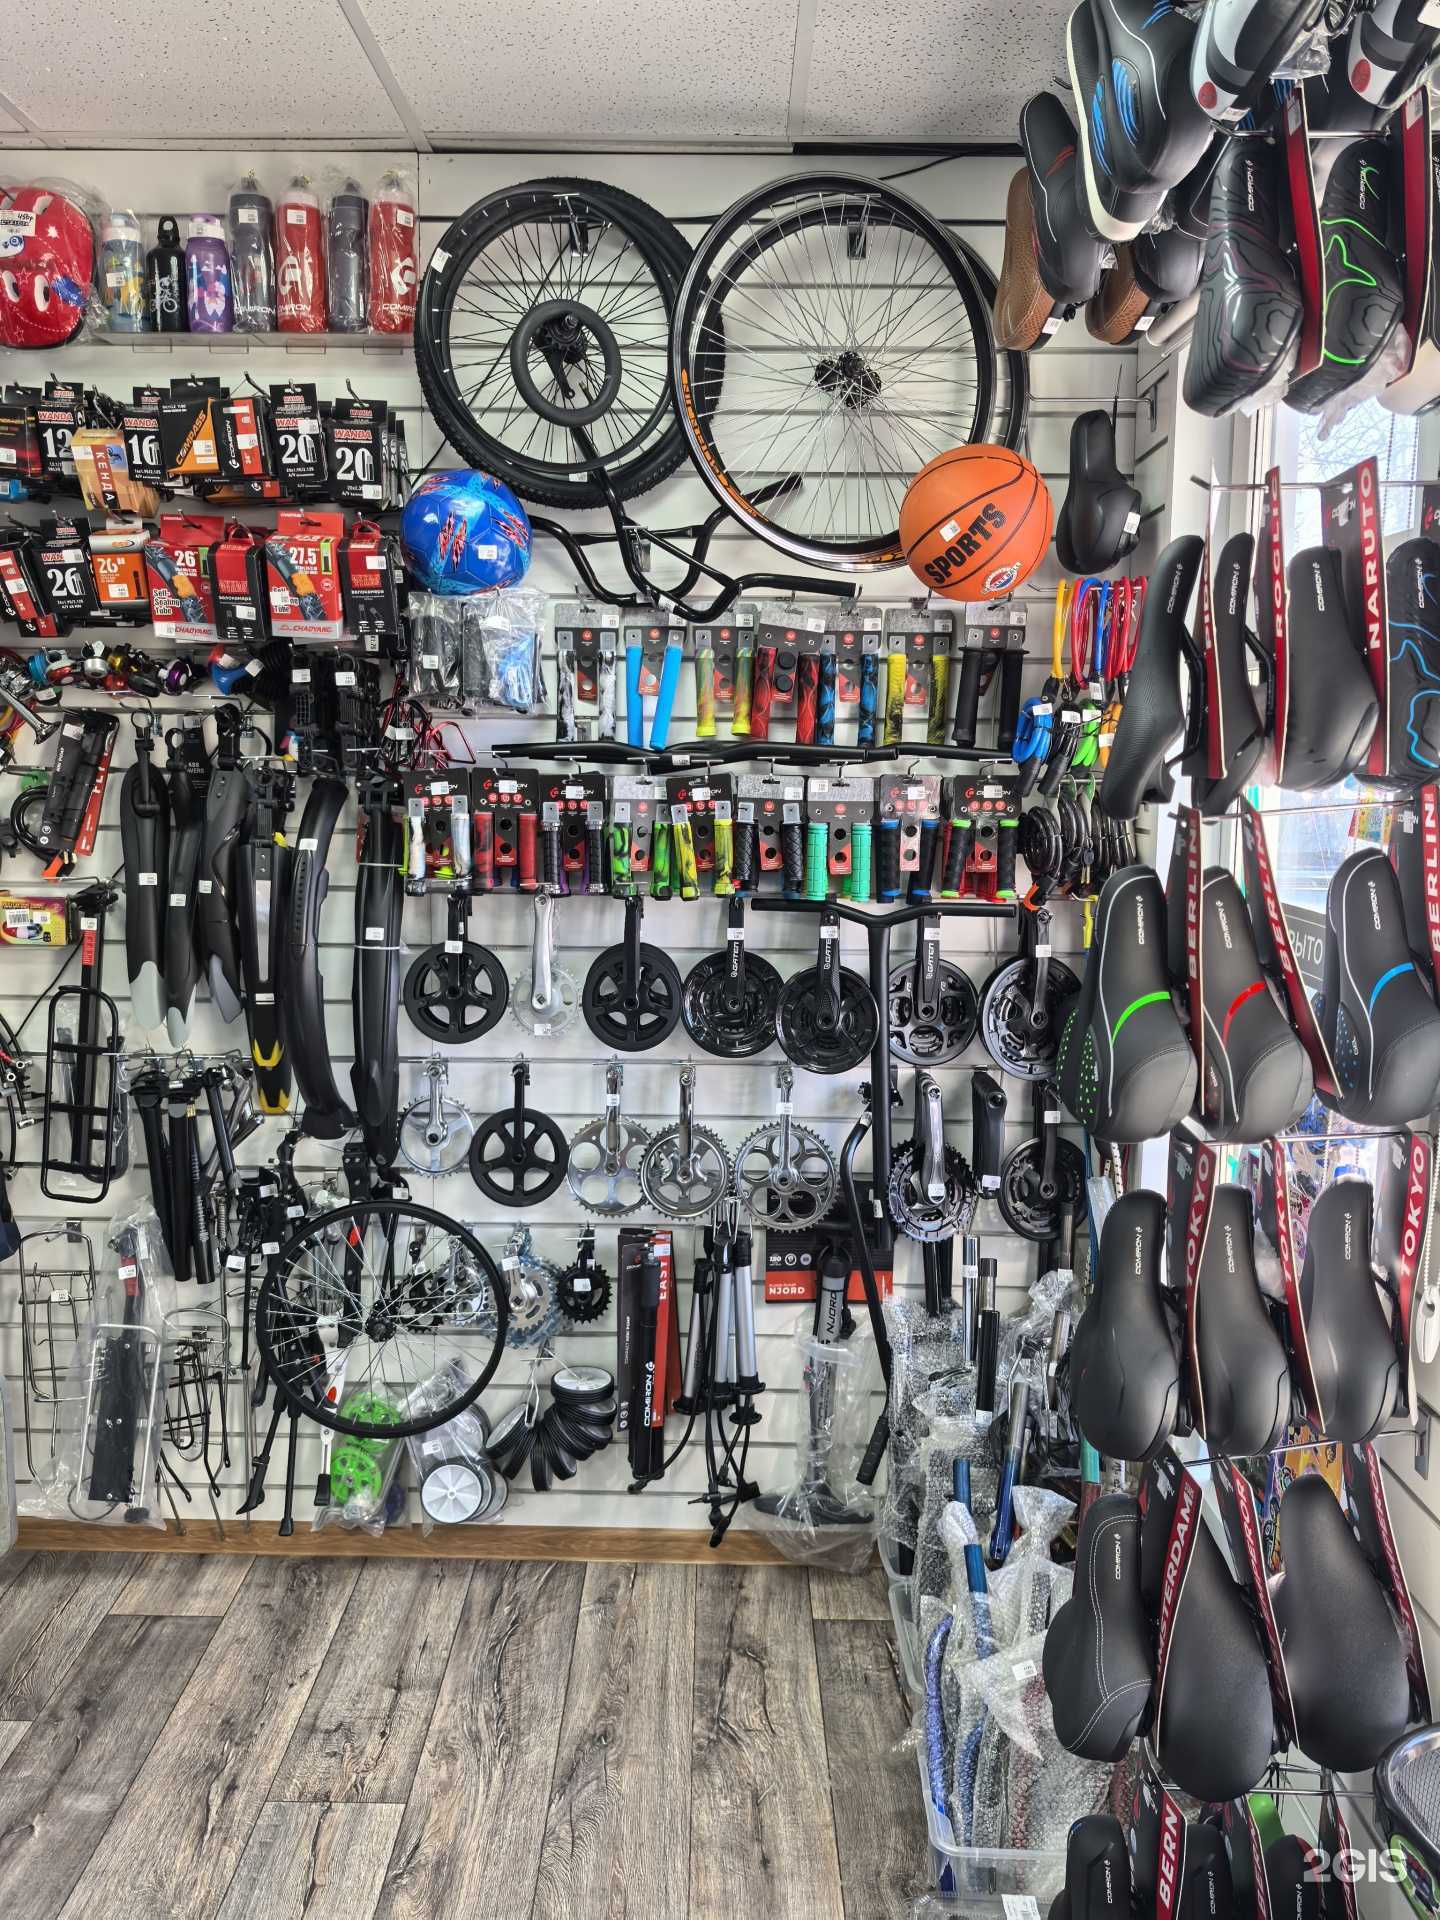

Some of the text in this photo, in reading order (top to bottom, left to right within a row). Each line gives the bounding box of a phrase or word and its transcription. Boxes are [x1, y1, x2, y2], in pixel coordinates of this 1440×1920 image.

[37, 410, 73, 421] WANDA
[123, 417, 158, 427] WANDA
[275, 418, 299, 427] WAN
[334, 429, 373, 440] WANDA
[42, 428, 73, 458] 12
[128, 433, 160, 466] 16
[175, 408, 206, 466] COMPASS
[224, 419, 236, 458] COMIRON
[279, 434, 314, 464] 20
[335, 447, 372, 481] 20
[42, 552, 64, 561] WAN
[924, 503, 1007, 584] SPORTS
[1271, 476, 1283, 638] ROGLIC
[1358, 467, 1380, 649] NARUTO
[47, 567, 85, 597] 26
[153, 589, 171, 598] Self-
[154, 597, 181, 608] Sealing
[1166, 570, 1181, 614] COMIRON
[1228, 570, 1240, 615] COMIRON
[1313, 569, 1325, 612] COMIRON
[1416, 566, 1425, 609] COMIRON
[155, 606, 172, 615] Tube
[1424, 803, 1440, 951] BERLIN
[1188, 826, 1198, 980] BERLIN
[1252, 829, 1293, 974] BERLIN
[1372, 886, 1382, 931] COMIRON
[1136, 903, 1146, 945] COMIRON
[1218, 907, 1234, 949] COMIRON
[1186, 1153, 1209, 1286] TOKYO
[1274, 1150, 1292, 1282] TOKYO
[1400, 1145, 1425, 1276] TOKYO
[1134, 1233, 1143, 1275] COMIRON
[1225, 1232, 1235, 1274] COMIRON
[768, 1286, 805, 1295] NJORD
[826, 1291, 837, 1334] NJORD
[643, 1374, 653, 1427] COMIRON
[1158, 1802, 1180, 1911] BERN
[1104, 1866, 1113, 1904] COMIRON
[1208, 1877, 1216, 1915] COMIRON
